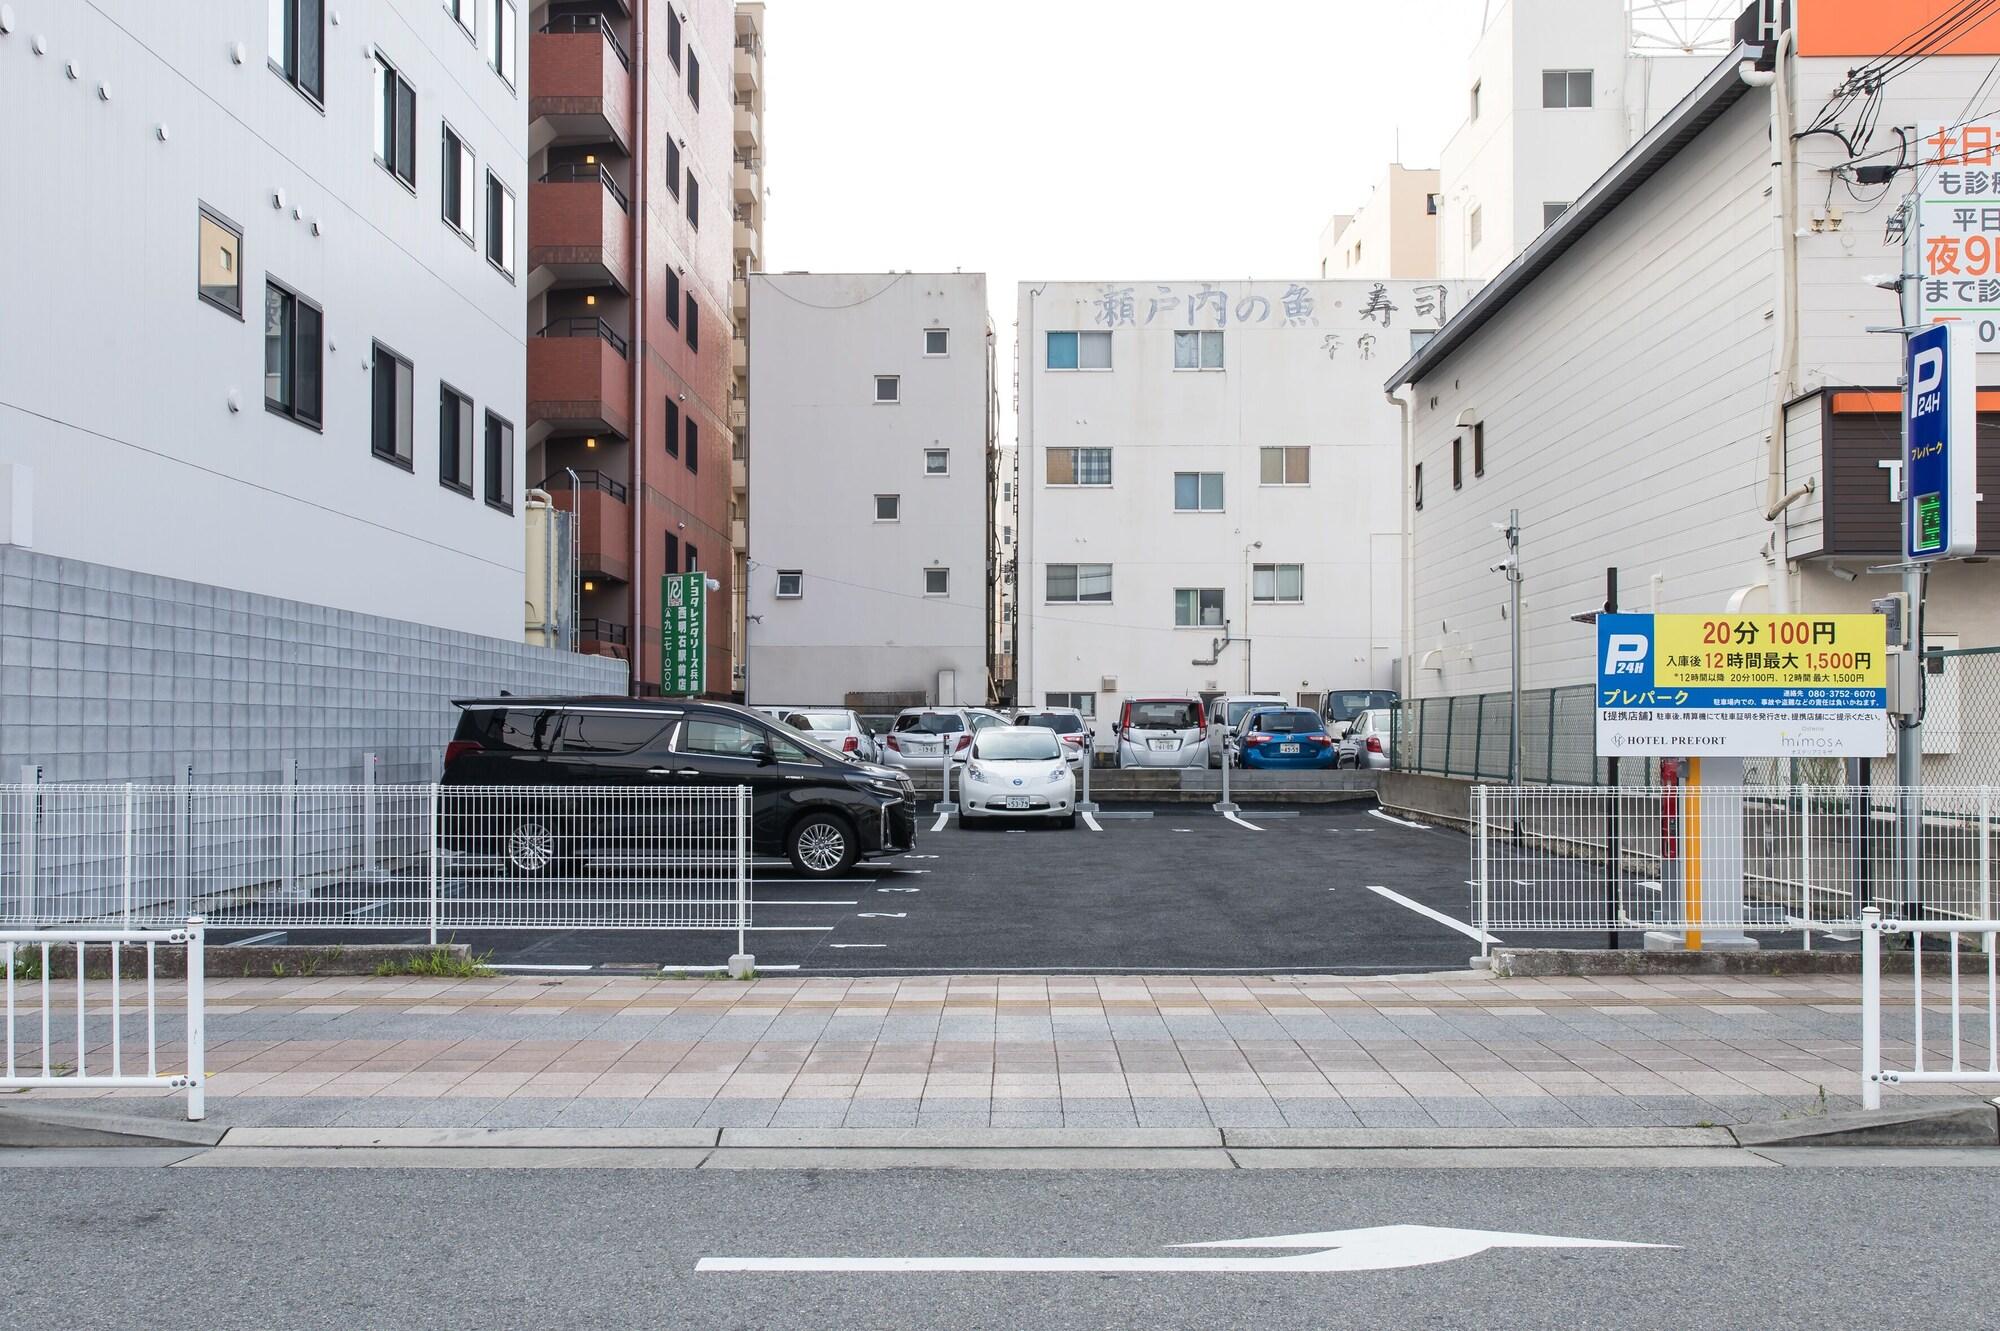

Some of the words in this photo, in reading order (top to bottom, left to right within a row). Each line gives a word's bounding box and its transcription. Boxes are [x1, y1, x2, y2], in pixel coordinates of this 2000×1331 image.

[1927, 126, 2000, 167] 土日
[1952, 207, 2000, 232] 平日
[1926, 235, 2000, 276] 夜9
[1978, 319, 2000, 343] 0
[1911, 346, 1943, 419] P
[1918, 391, 1941, 417] 24H
[1768, 620, 1835, 645] 100円
[1604, 633, 1649, 675] P
[1616, 662, 1644, 674] 24H
[1603, 688, 1689, 706] プレパーク
[1808, 690, 1876, 698] 080-3752-6070
[1627, 736, 1669, 745] HOTEL
[1671, 736, 1727, 745] PREFORT
